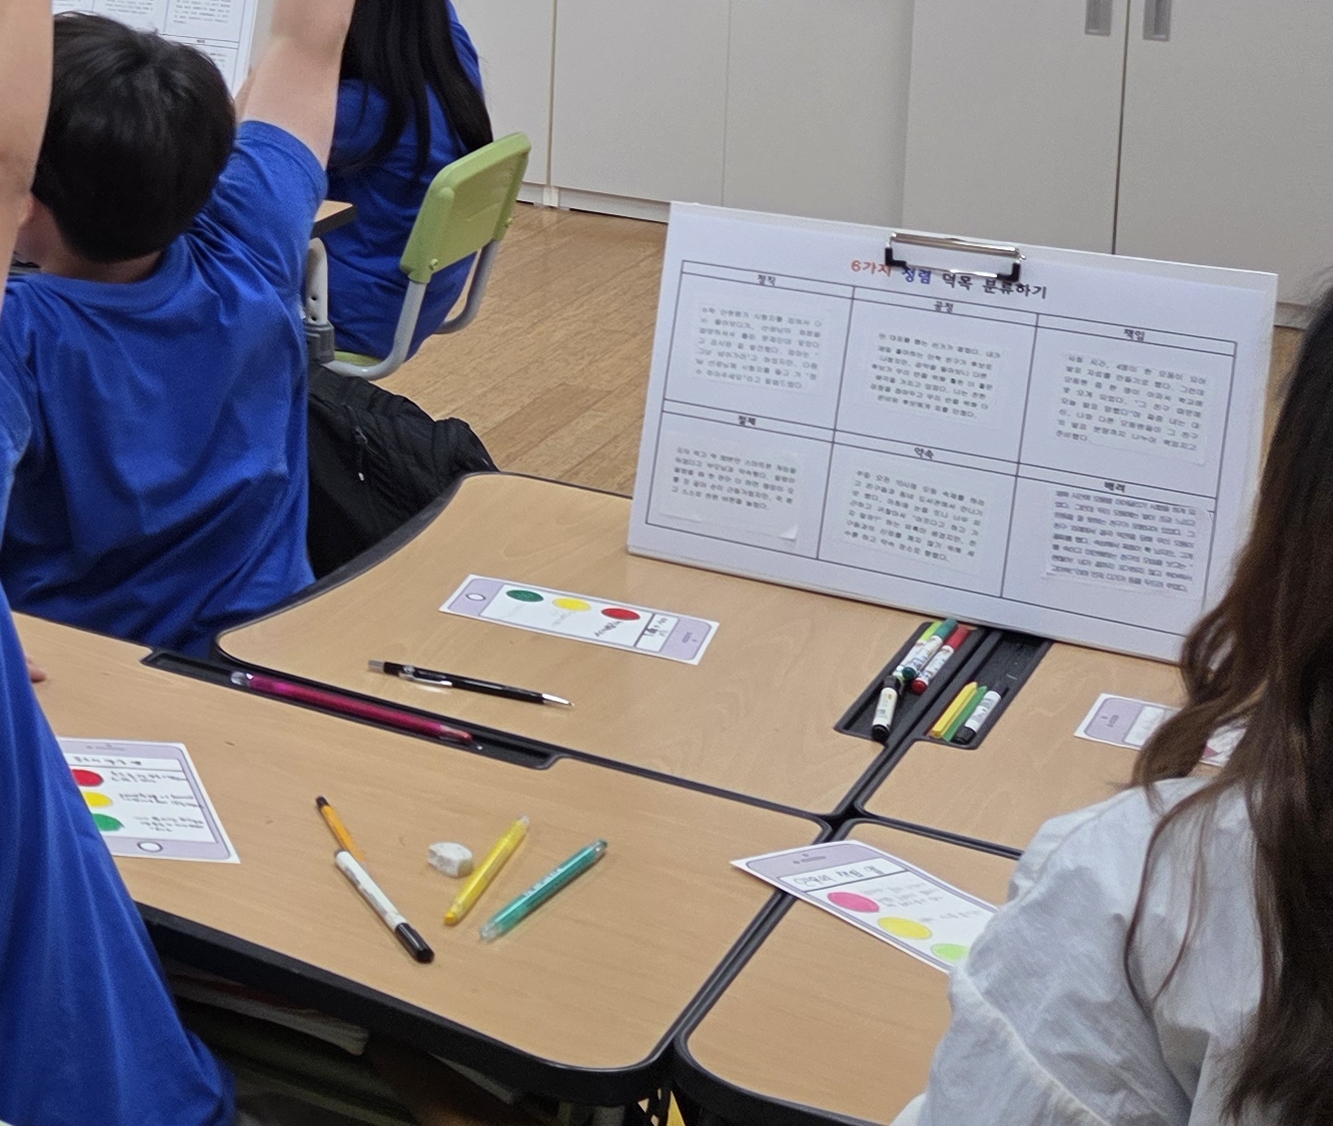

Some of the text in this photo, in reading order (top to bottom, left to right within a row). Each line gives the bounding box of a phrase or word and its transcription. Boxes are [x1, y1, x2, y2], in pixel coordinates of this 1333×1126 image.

[851, 260, 892, 277] 6가지
[1124, 328, 1145, 341] 책임
[914, 447, 934, 459] 약속
